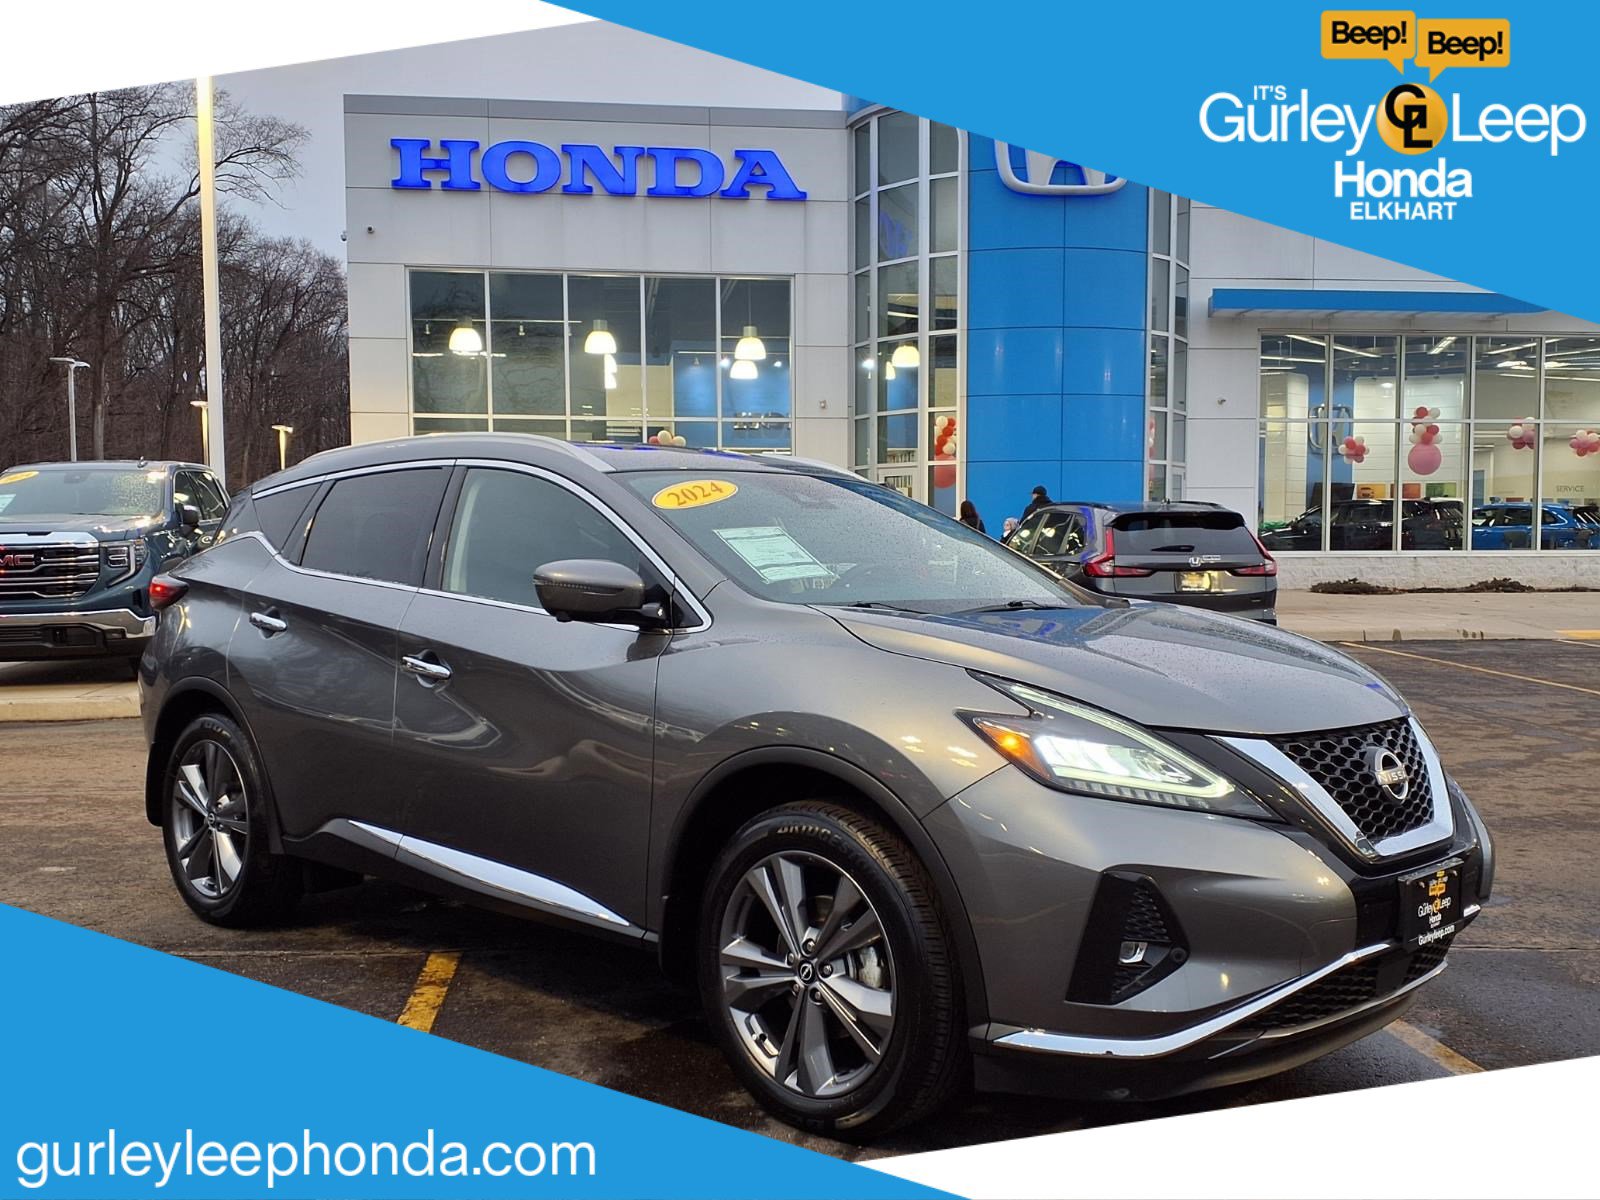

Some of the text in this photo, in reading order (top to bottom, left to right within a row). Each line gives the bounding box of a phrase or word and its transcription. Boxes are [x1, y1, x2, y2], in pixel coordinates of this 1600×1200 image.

[389, 138, 808, 201] HONDA
[666, 481, 724, 506] 2024
[1556, 485, 1585, 494] SERVICE
[1377, 769, 1407, 785] NISS
